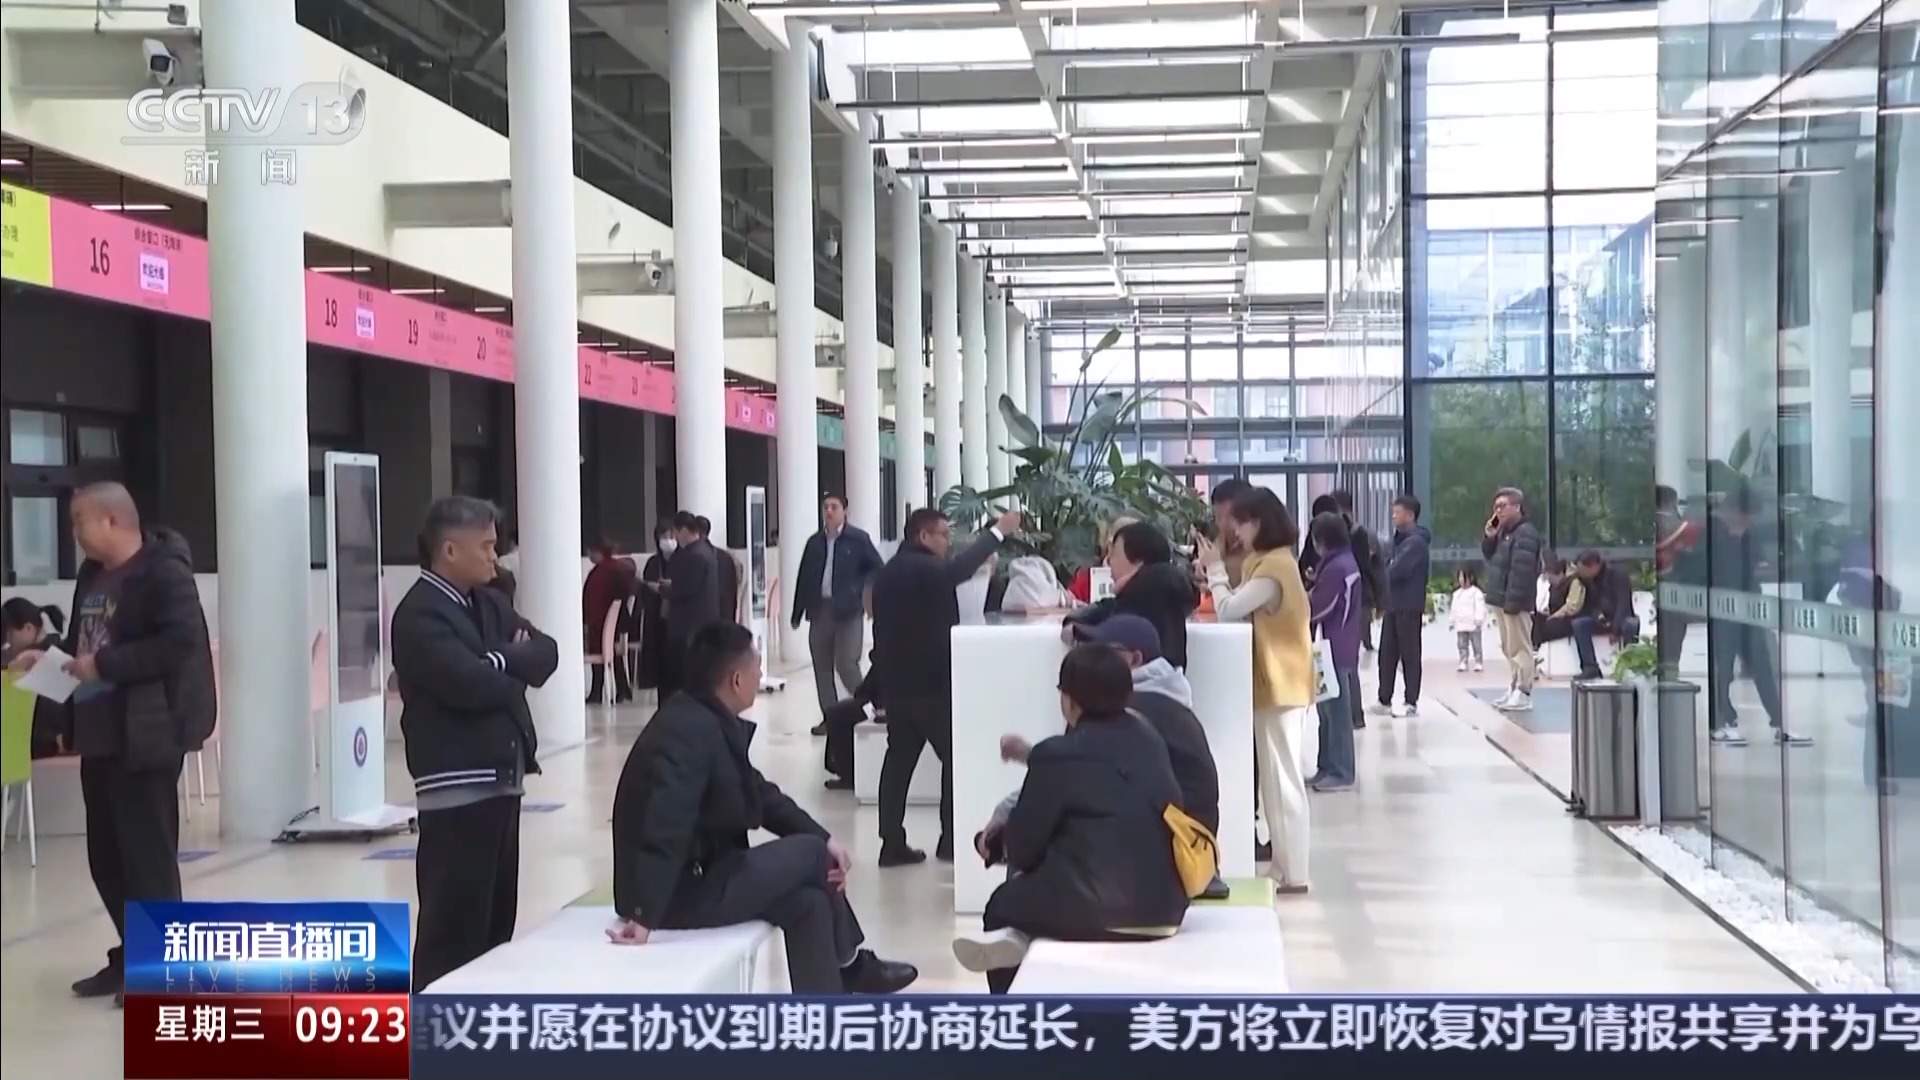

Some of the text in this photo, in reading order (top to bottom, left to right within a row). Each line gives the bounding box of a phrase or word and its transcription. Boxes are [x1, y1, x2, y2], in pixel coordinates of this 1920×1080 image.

[90, 237, 110, 276] 16
[324, 297, 338, 328] 18
[408, 319, 419, 346] 19
[477, 336, 487, 361] 20
